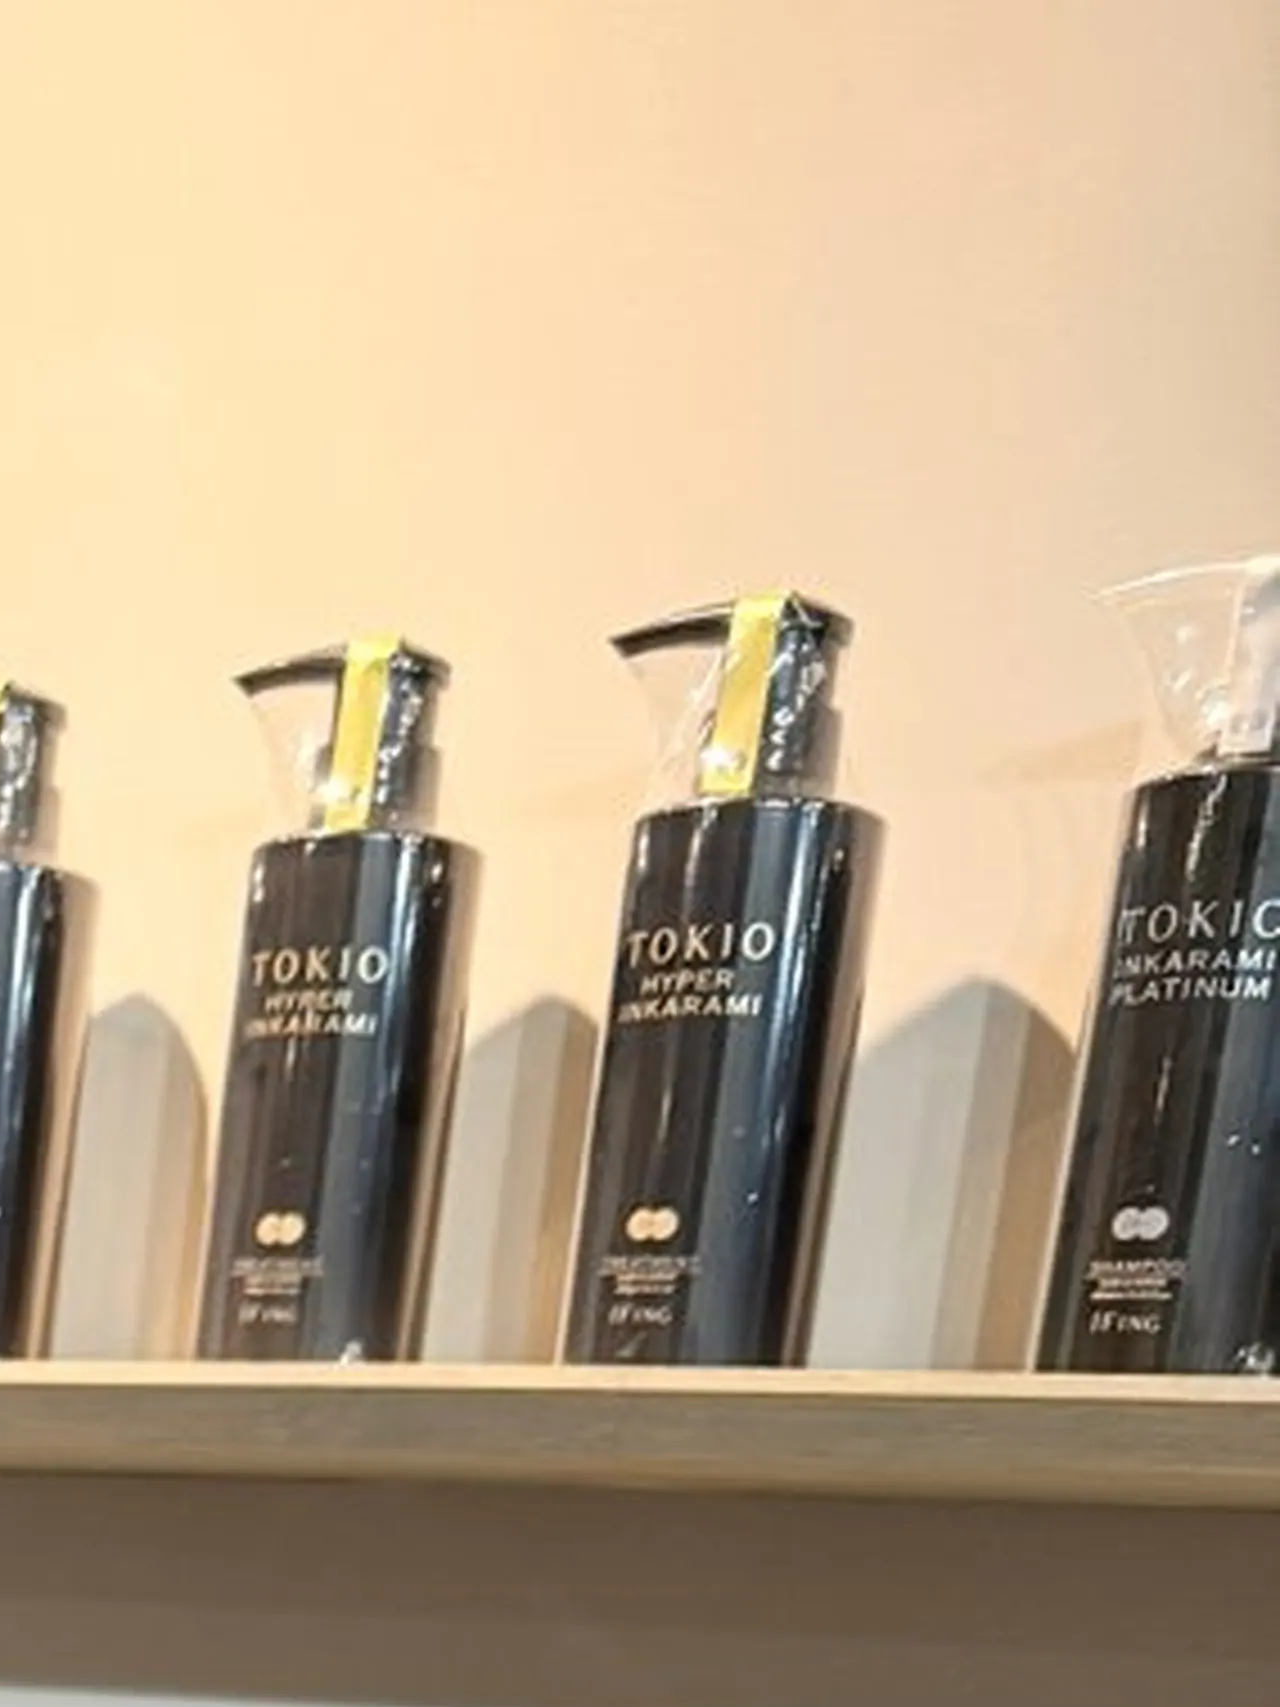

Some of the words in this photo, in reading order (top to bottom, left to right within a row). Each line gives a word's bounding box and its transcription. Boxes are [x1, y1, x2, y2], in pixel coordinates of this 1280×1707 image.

[626, 921, 775, 968] TOKIO
[252, 946, 390, 986] TOKIO
[641, 968, 734, 996] HYPER
[1108, 975, 1271, 1006] PLATINUM
